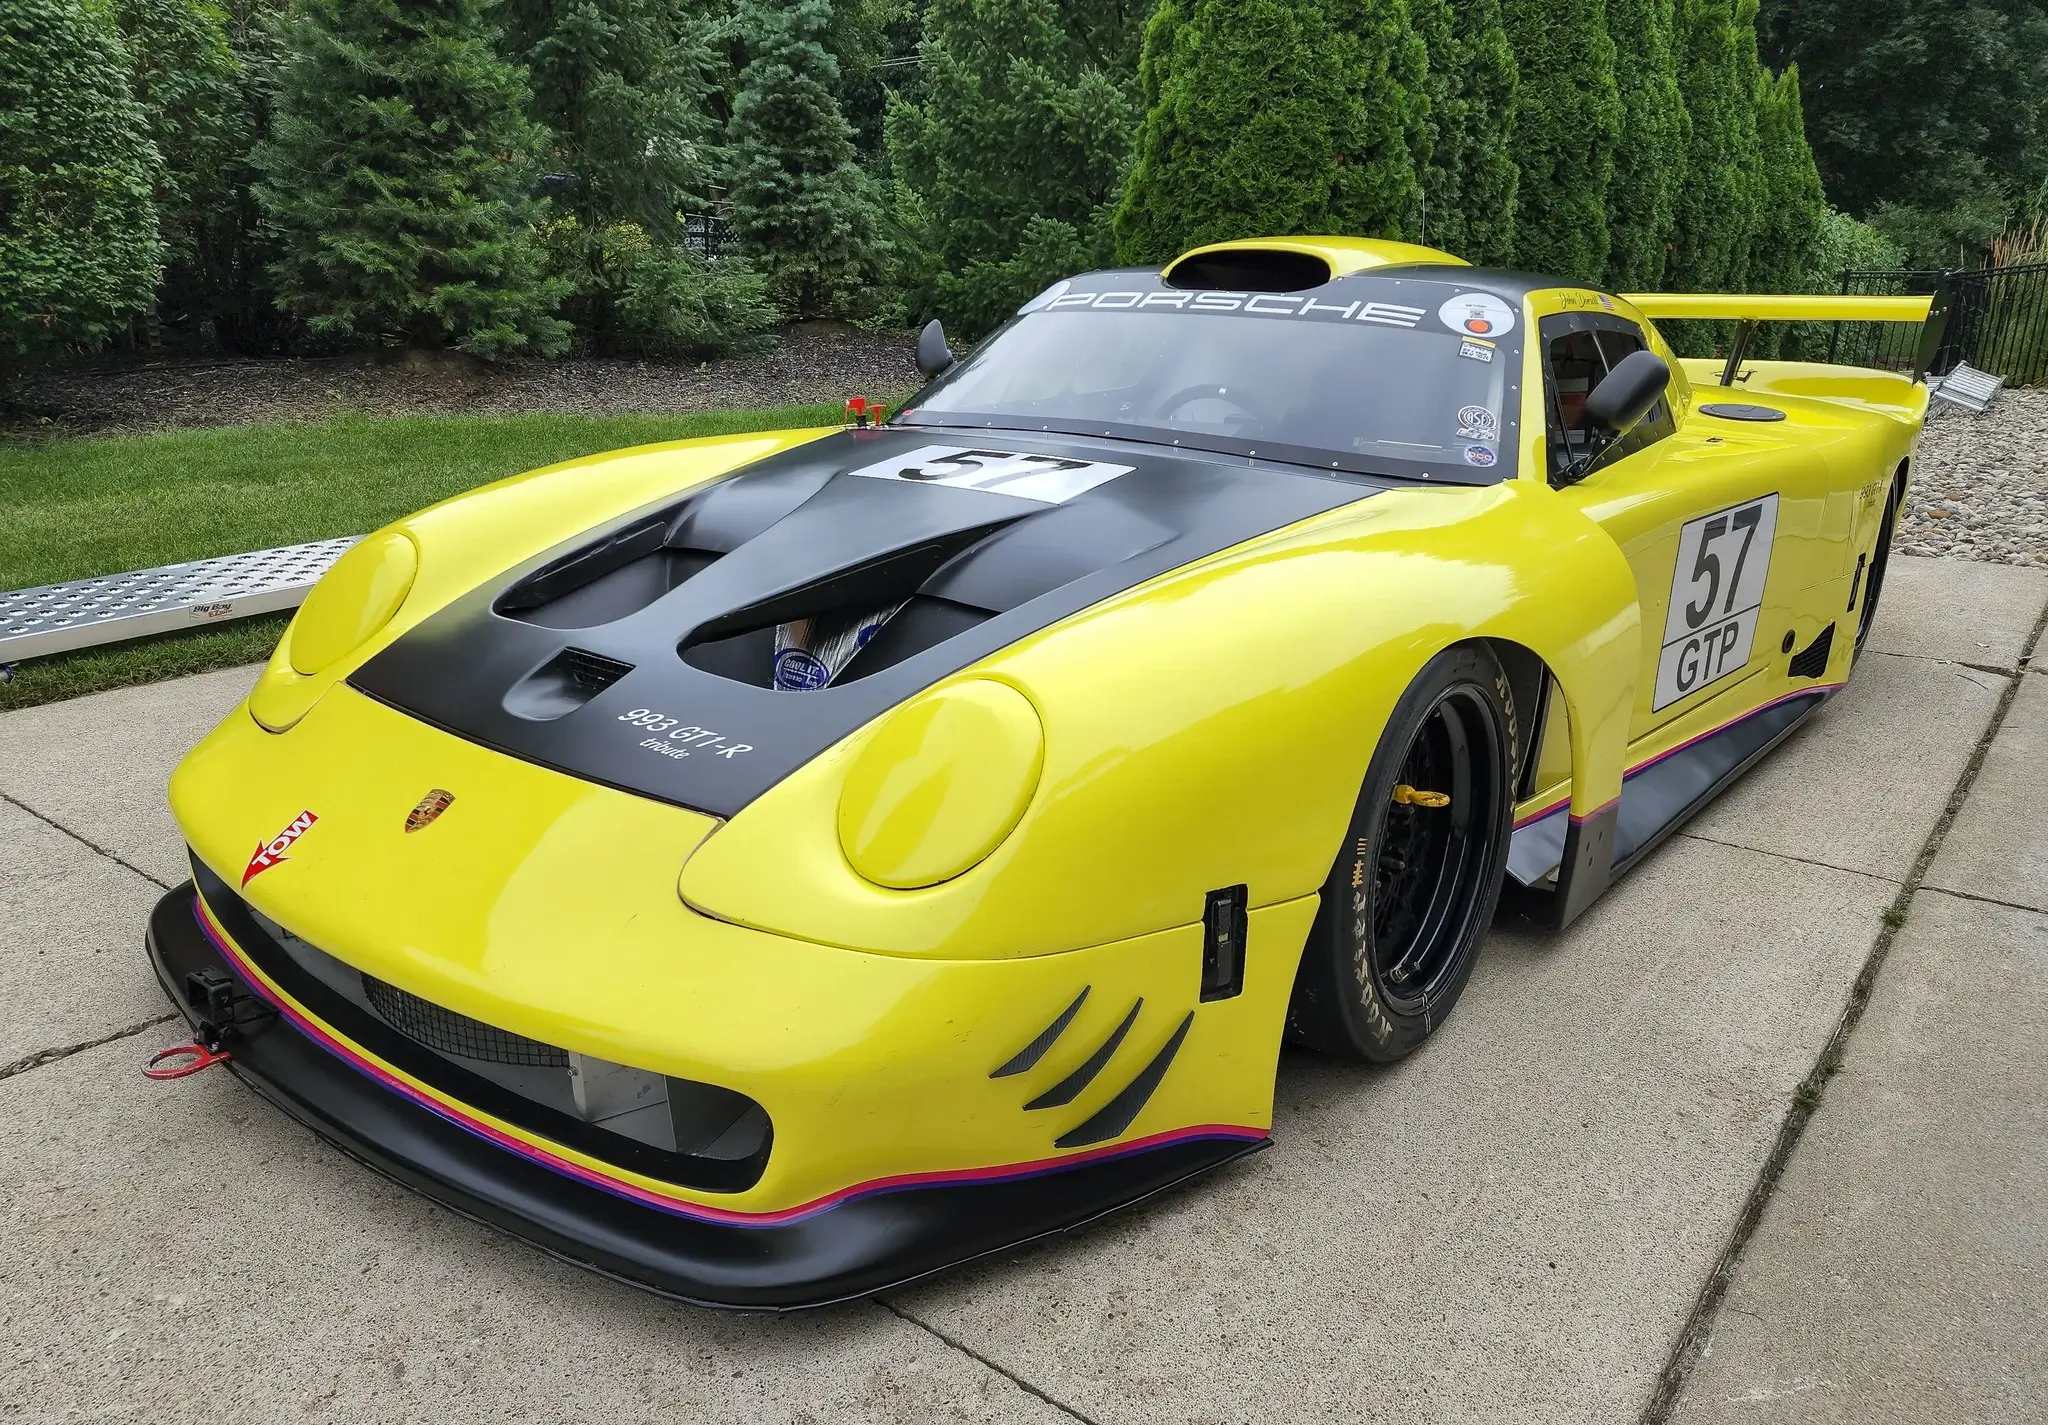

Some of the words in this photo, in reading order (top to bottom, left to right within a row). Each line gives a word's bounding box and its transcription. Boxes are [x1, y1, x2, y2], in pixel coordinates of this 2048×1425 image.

[1046, 291, 1426, 328] PORSCHE
[898, 449, 1095, 489] 57
[1685, 503, 1763, 629] 57
[783, 658, 805, 672] COOL
[806, 665, 819, 675] IT
[1676, 621, 1740, 692] GTP
[617, 708, 679, 731] 993
[669, 726, 754, 758] GT1-R
[639, 738, 690, 759] tribute
[251, 812, 313, 866] TOW
